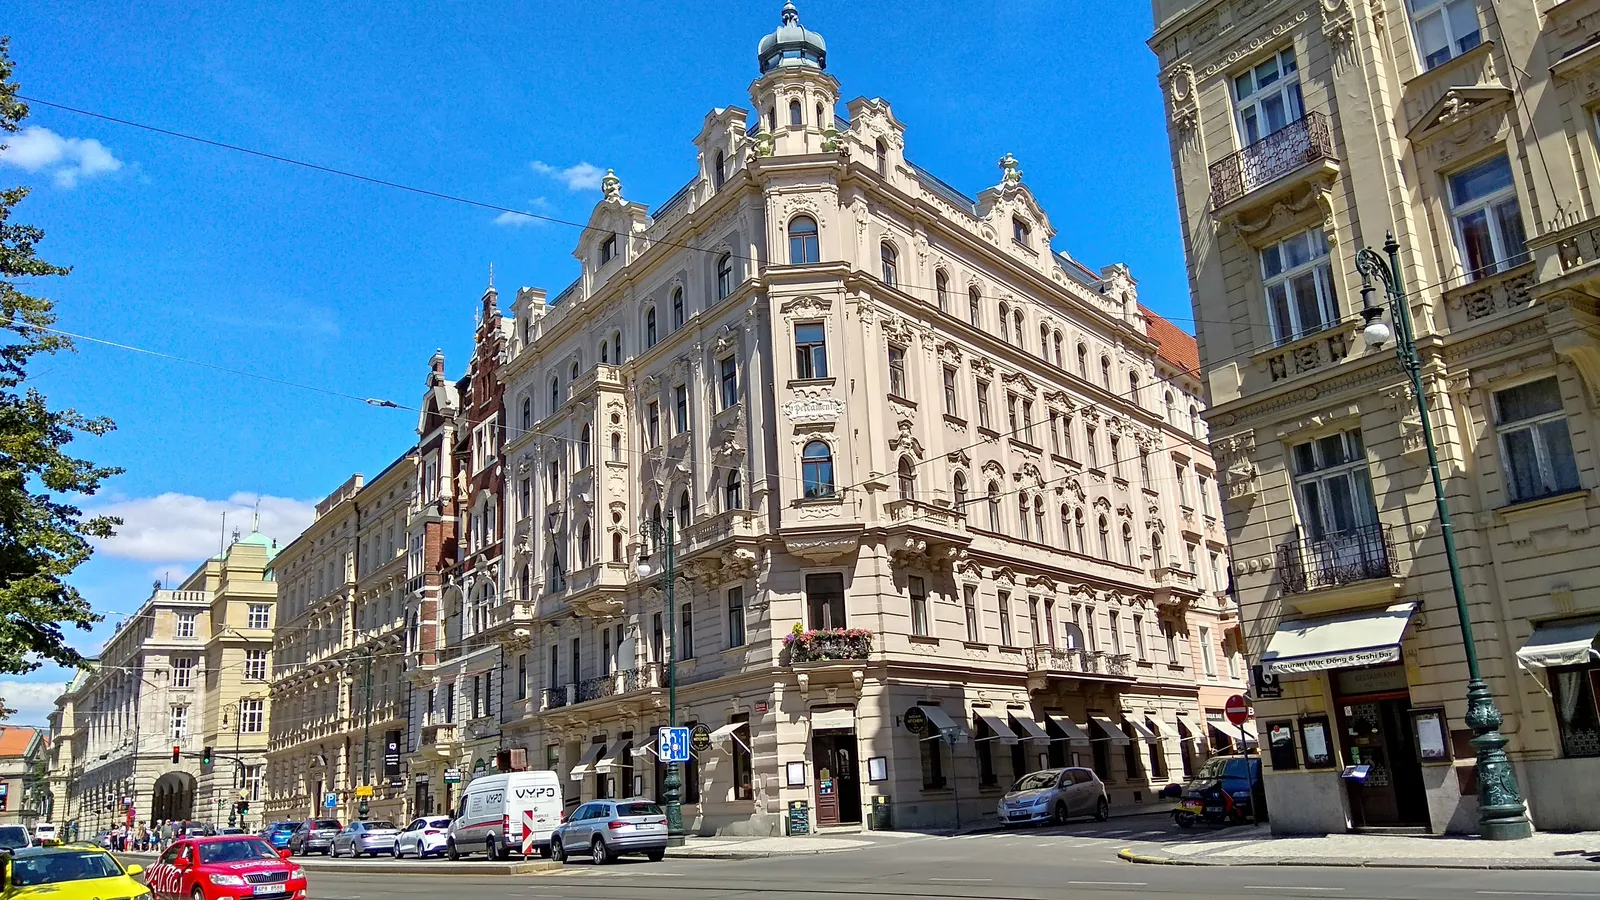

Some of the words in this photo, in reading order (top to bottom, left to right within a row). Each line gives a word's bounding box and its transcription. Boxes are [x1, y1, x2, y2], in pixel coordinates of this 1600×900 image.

[1268, 661, 1308, 671] Restaurant
[1356, 652, 1378, 661] Sushi
[515, 787, 555, 799] VYPO
[328, 795, 335, 804] P
